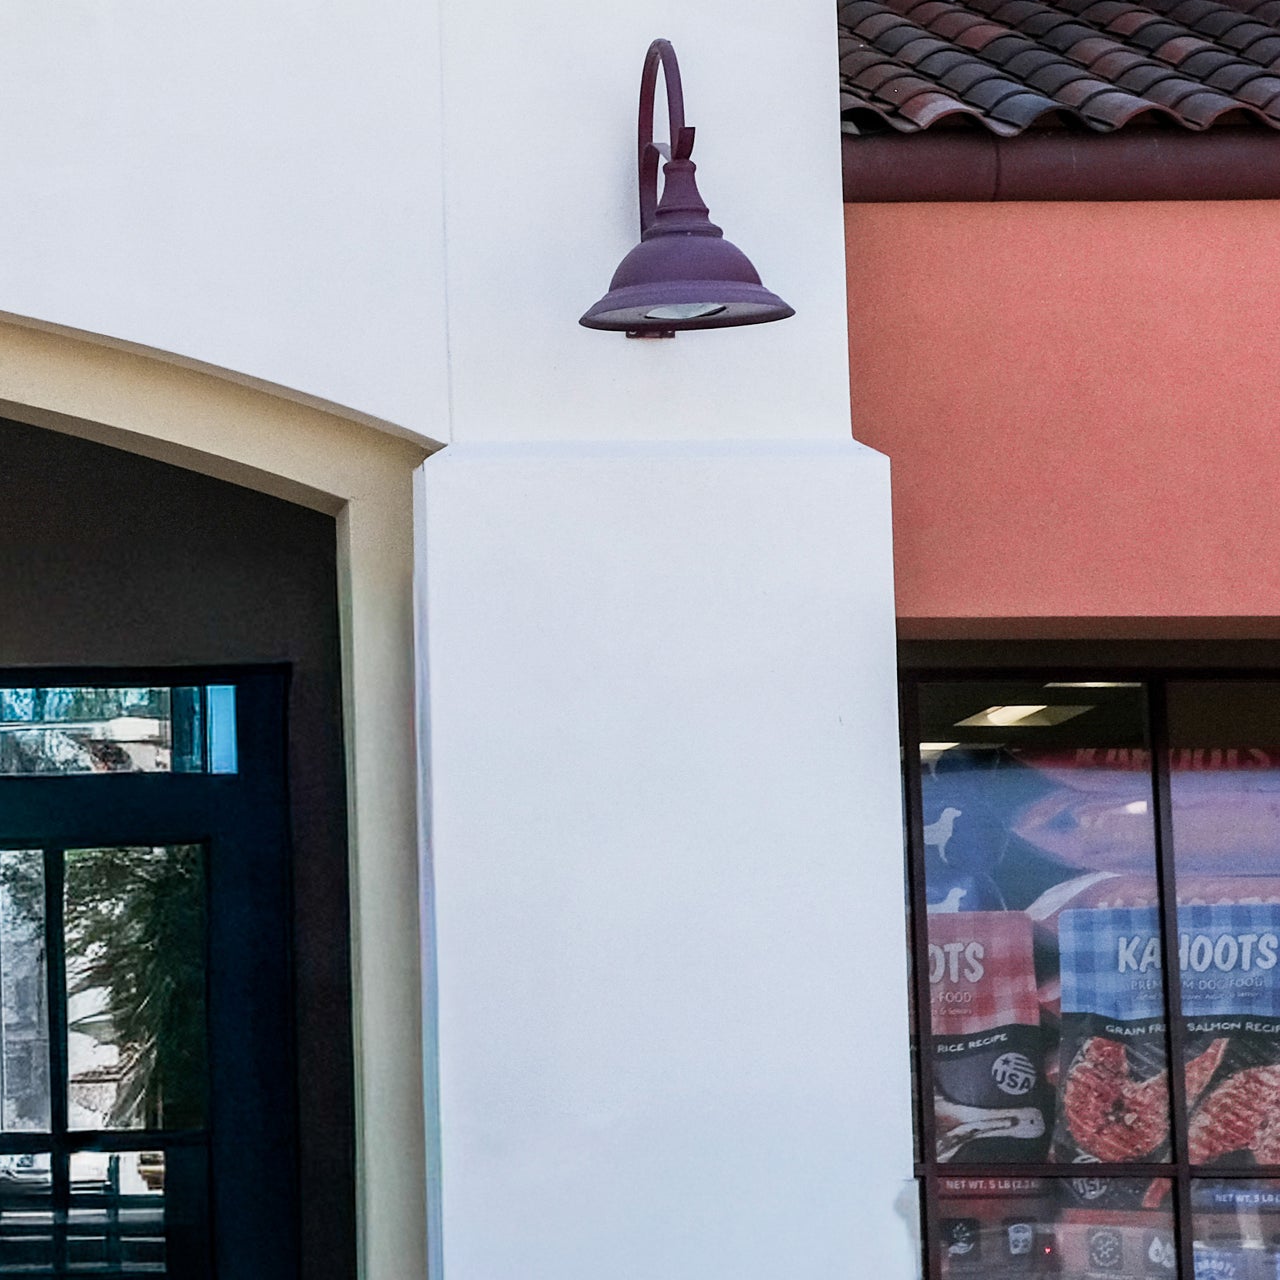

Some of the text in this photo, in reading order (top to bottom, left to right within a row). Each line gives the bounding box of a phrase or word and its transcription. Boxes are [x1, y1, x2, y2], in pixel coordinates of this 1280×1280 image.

[939, 991, 972, 1003] FOOD
[1105, 1025, 1146, 1036] GRAIN
[1187, 1022, 1241, 1032] SALMON
[937, 1033, 1009, 1053] RICE RECIPE
[993, 1068, 1033, 1091] USA
[946, 1180, 966, 1189] NET
[989, 1180, 996, 1189] 5
[998, 1180, 1011, 1189] LB
